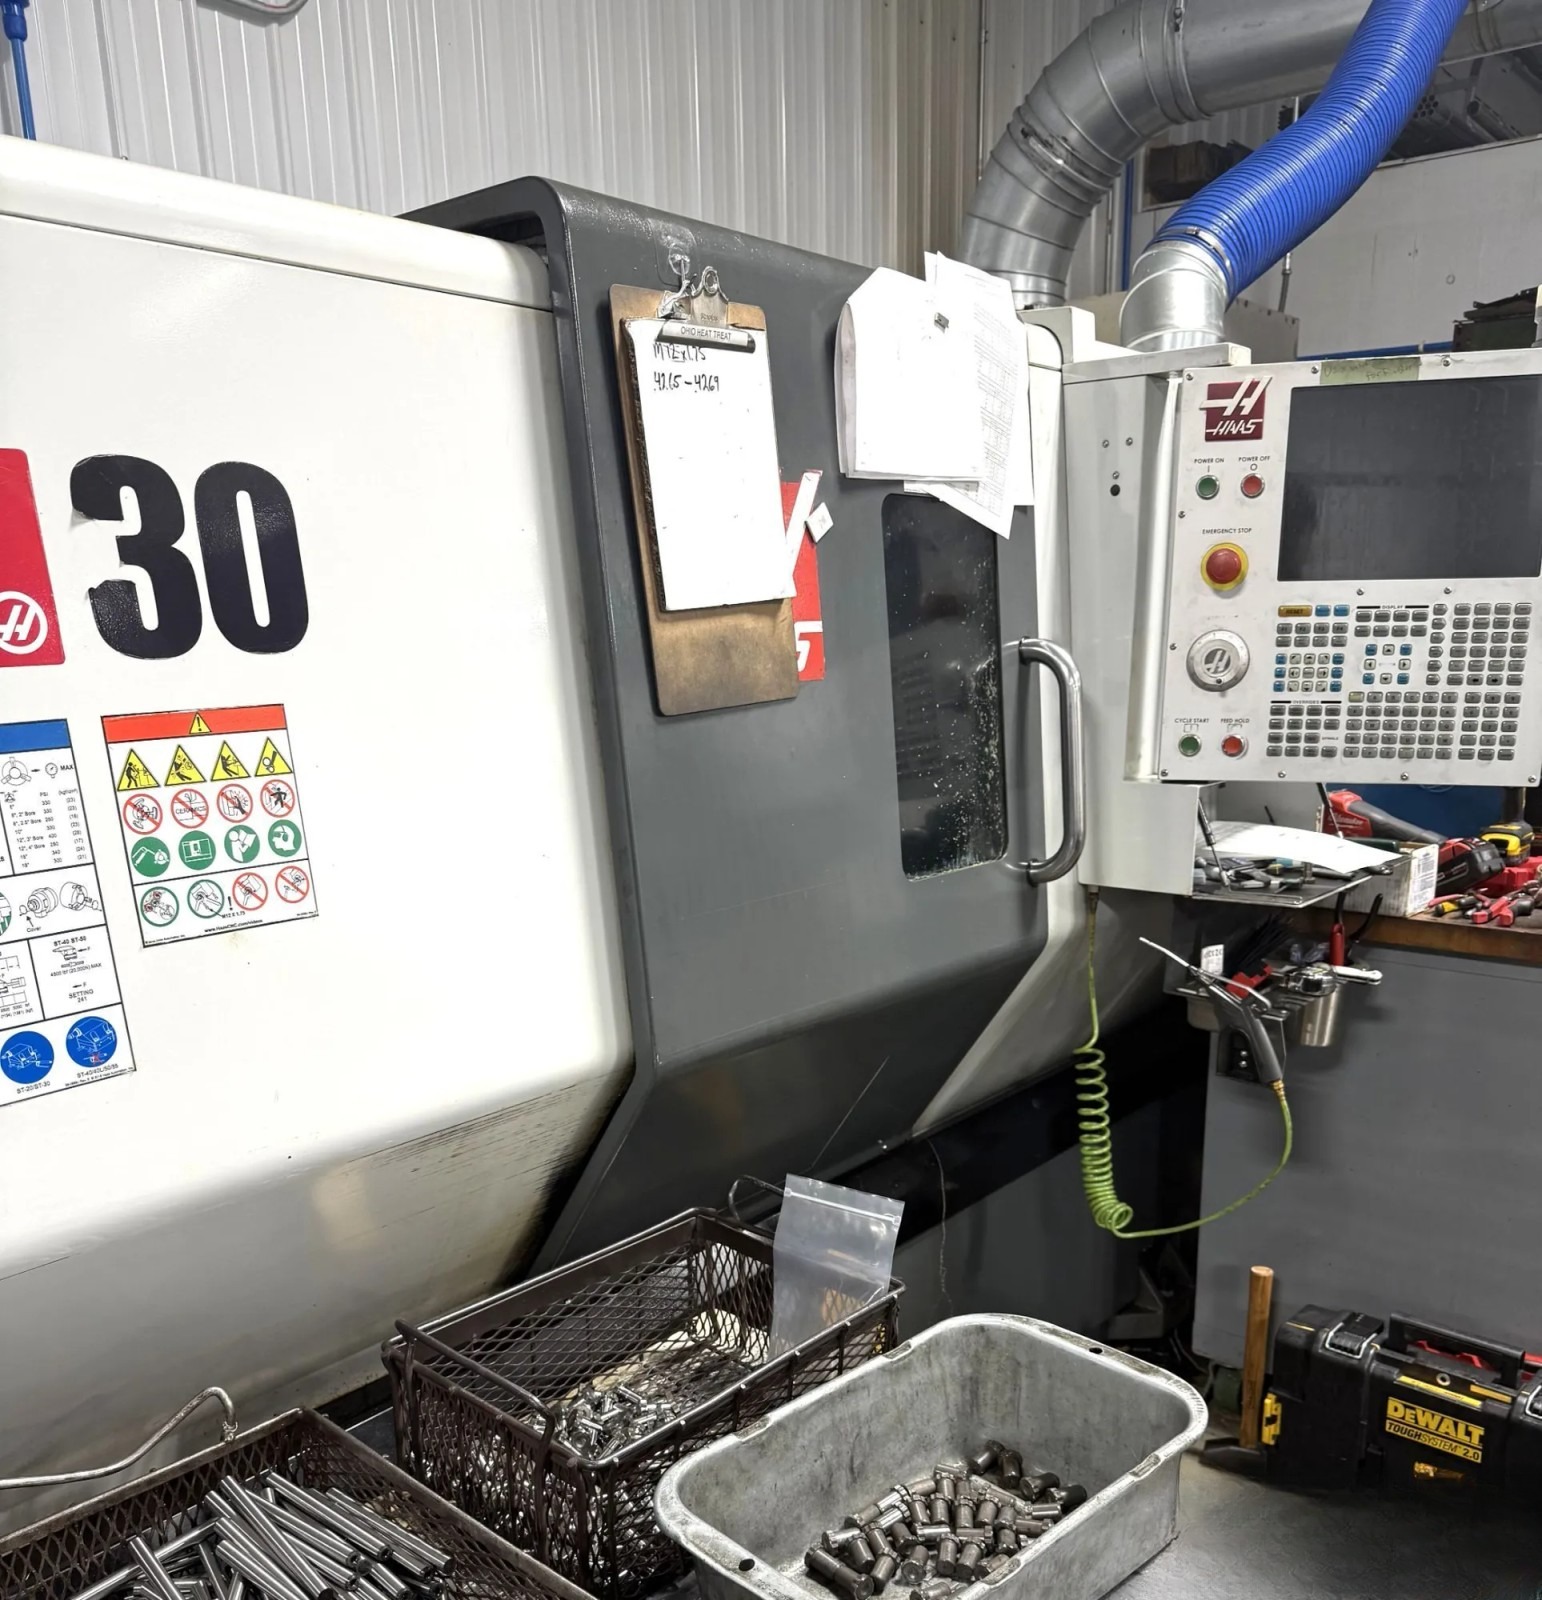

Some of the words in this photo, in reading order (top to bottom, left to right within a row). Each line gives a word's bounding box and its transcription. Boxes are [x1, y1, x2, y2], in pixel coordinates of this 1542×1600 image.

[680, 326, 696, 336] OHIO
[696, 329, 712, 338] HEAT
[713, 330, 731, 341] TREAT
[1206, 419, 1263, 436] HAAS
[69, 454, 310, 659] 30
[68, 989, 94, 999] SETTING
[1462, 1447, 1480, 1461] 2.0
